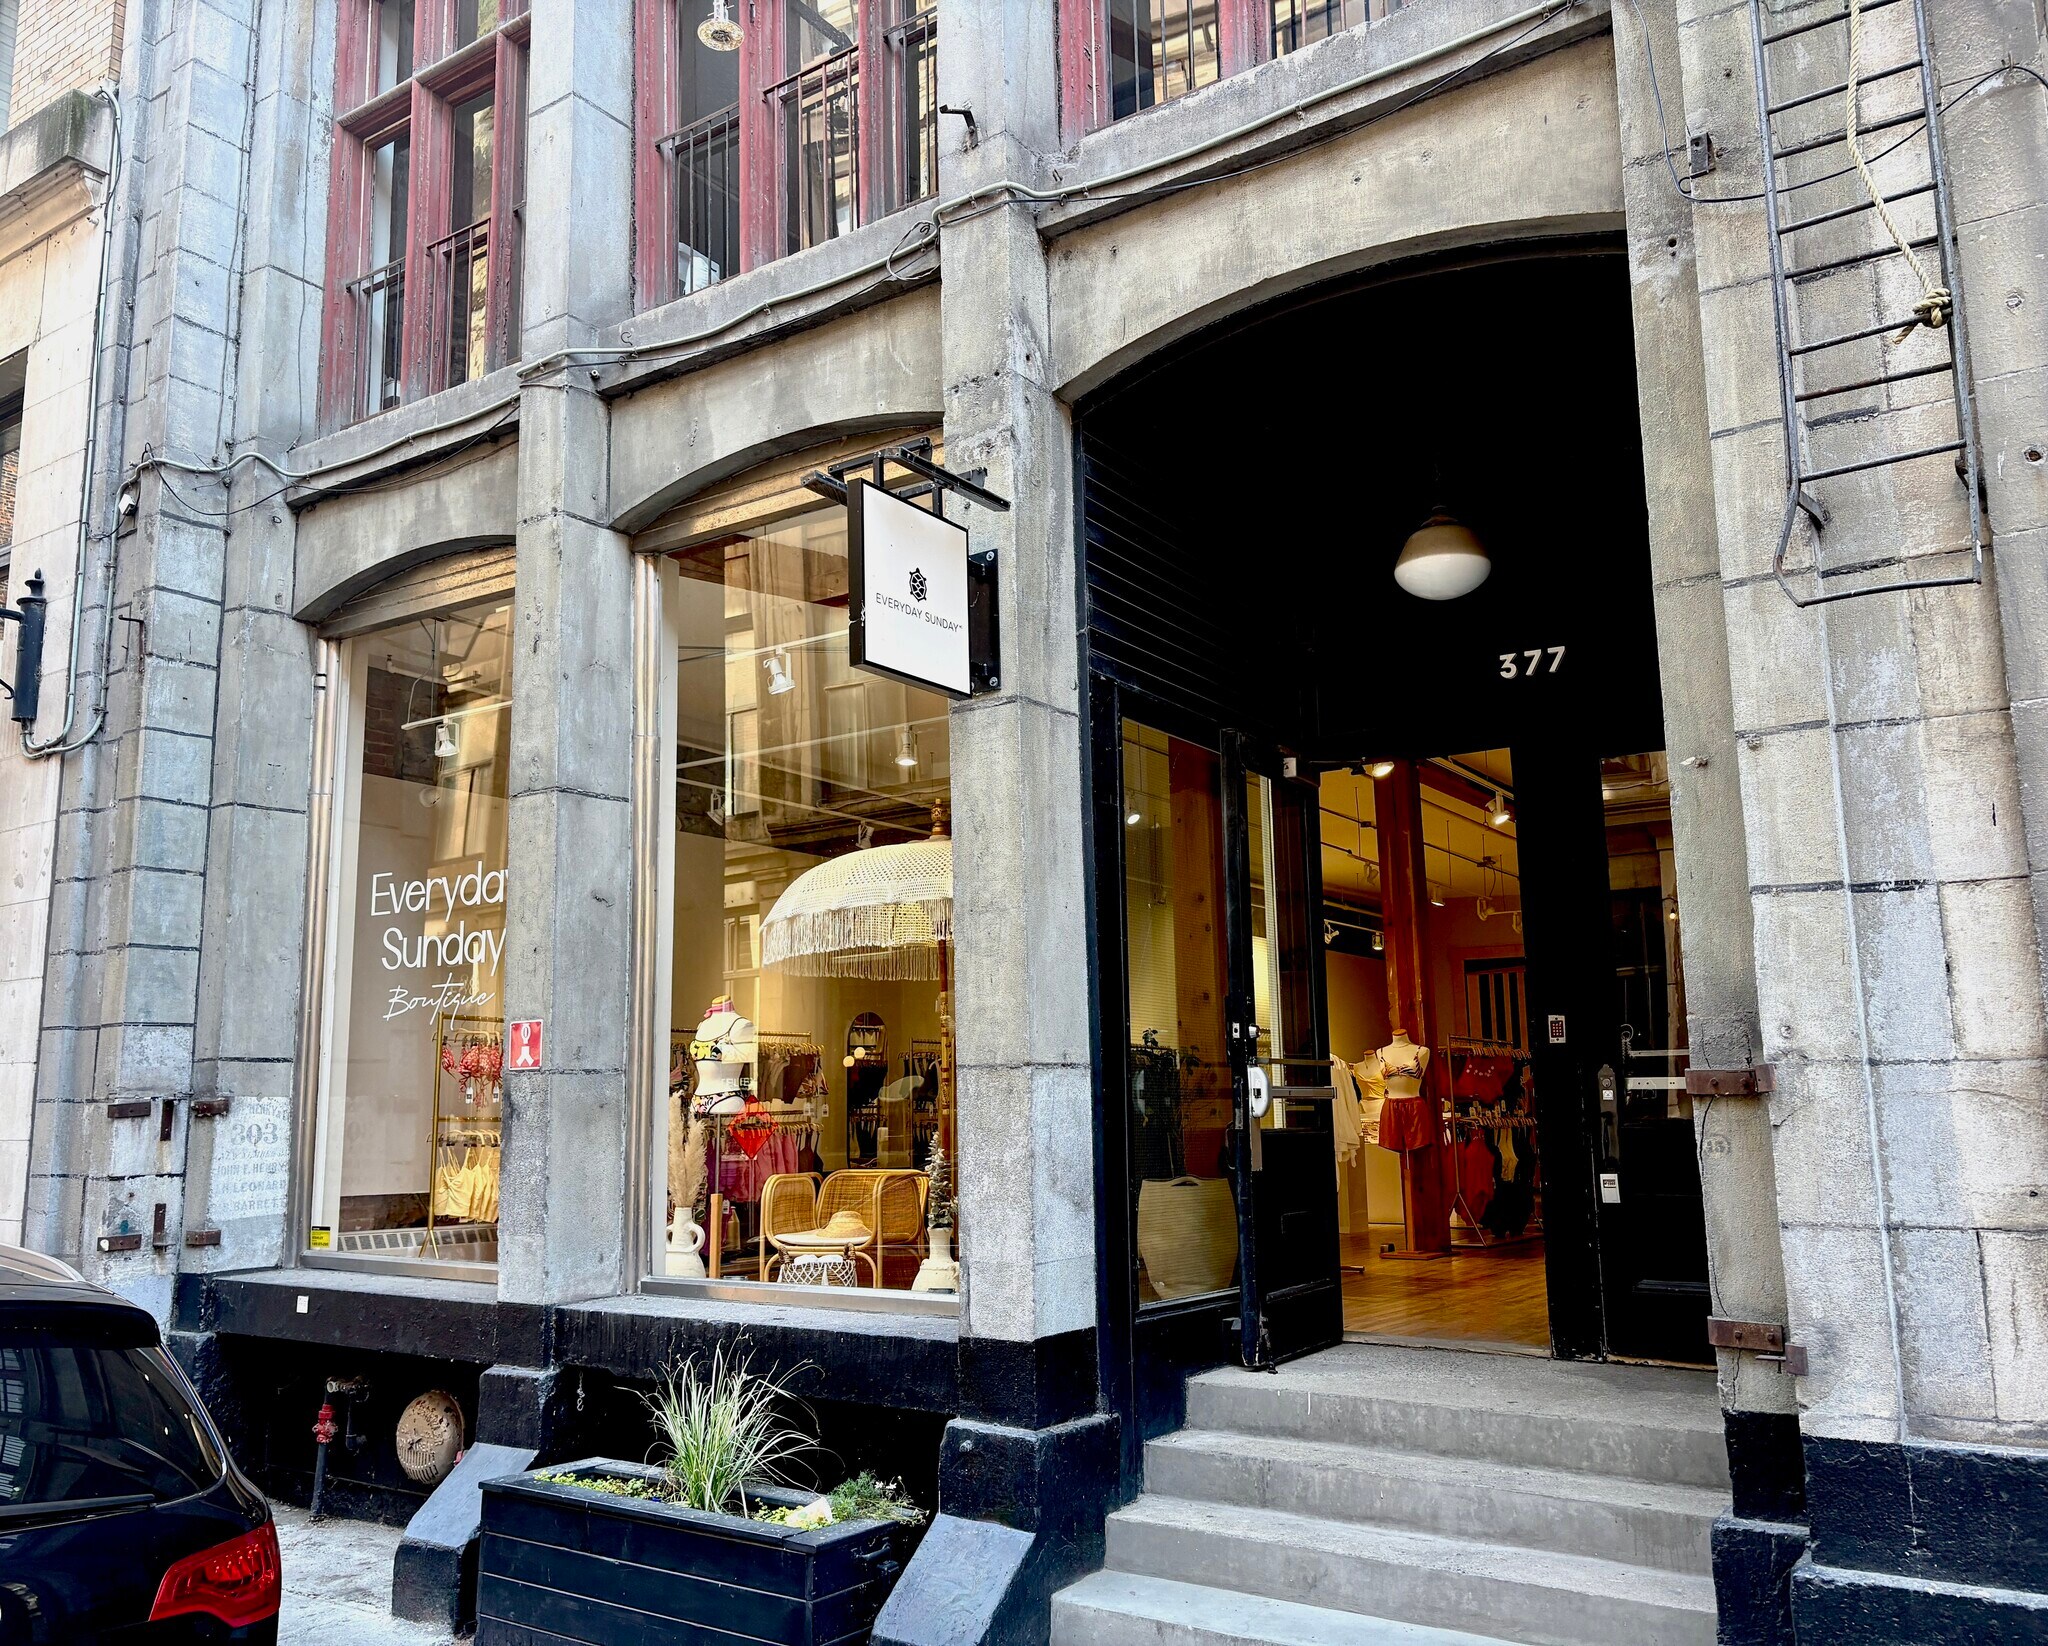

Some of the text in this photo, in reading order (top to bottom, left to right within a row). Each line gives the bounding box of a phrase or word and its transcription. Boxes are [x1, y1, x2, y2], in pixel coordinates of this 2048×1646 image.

[875, 592, 922, 619] EVERYDAY
[1499, 645, 1566, 680] 377
[371, 860, 508, 922] Everyda
[381, 920, 507, 977] Sunday
[382, 972, 496, 1031] Boutique
[231, 1122, 279, 1146] 303
